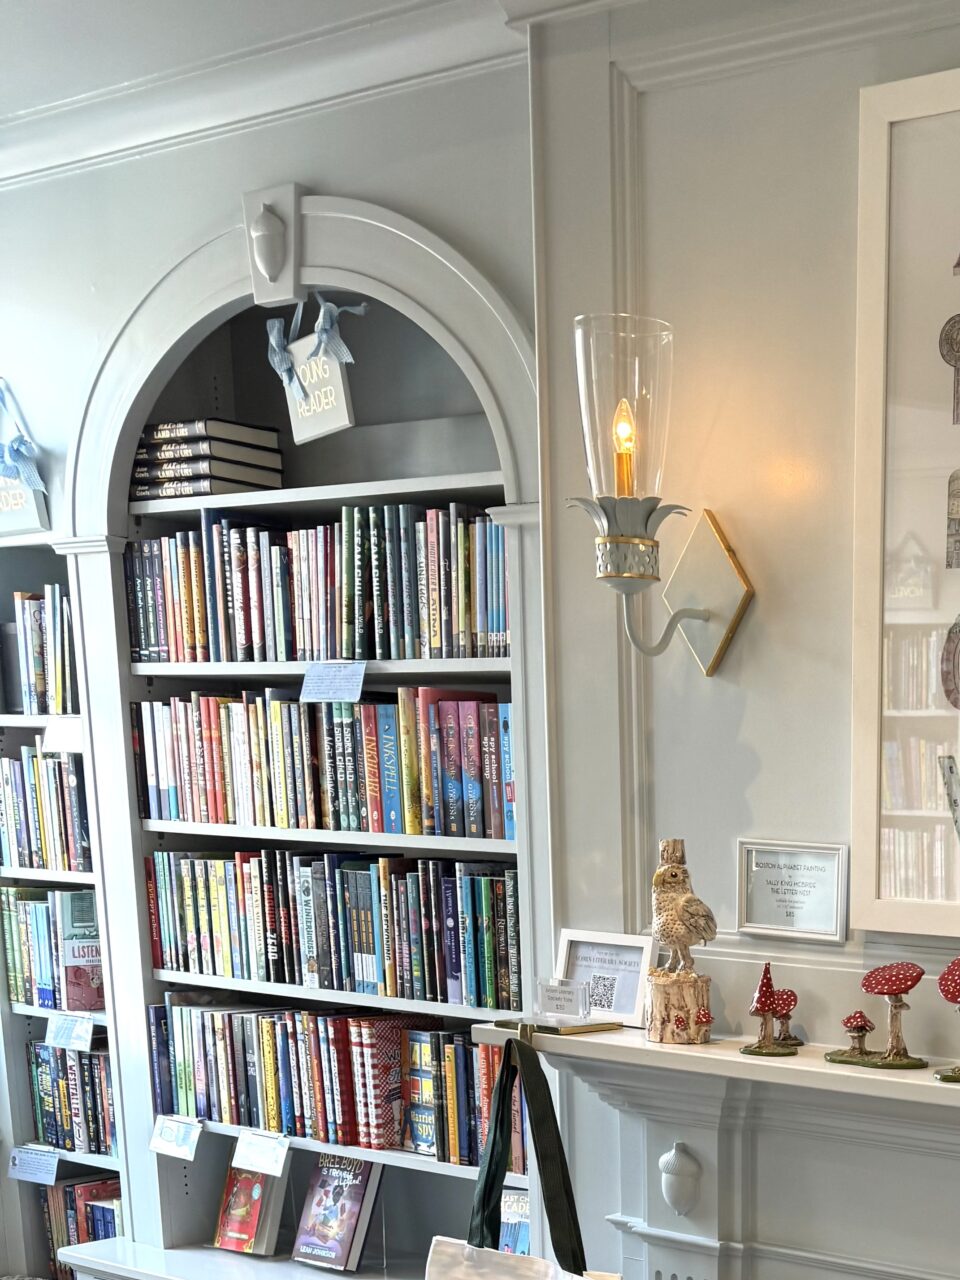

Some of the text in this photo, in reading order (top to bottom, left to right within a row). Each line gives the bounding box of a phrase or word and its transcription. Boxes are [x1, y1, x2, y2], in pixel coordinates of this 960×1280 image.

[154, 430, 170, 438] LAND
[370, 529, 379, 564] TEAM
[372, 569, 380, 594] CHU
[418, 561, 427, 610] UNSTUCK
[324, 736, 335, 797] NOT NOTHING
[365, 735, 380, 800] INKHEART
[383, 735, 397, 793] INKSPELL
[448, 783, 456, 820] GIBBONS
[468, 783, 476, 821] GIBBONS
[264, 884, 278, 960] GROUND ZERO
[304, 899, 315, 955] WINTERHOUSE
[498, 919, 506, 955] REDWALL
[68, 1064, 80, 1117] WESTFALLEN
[418, 1123, 434, 1138] spy
[512, 1109, 520, 1135] Tunnel
[318, 1152, 365, 1173] BREE BOYD
